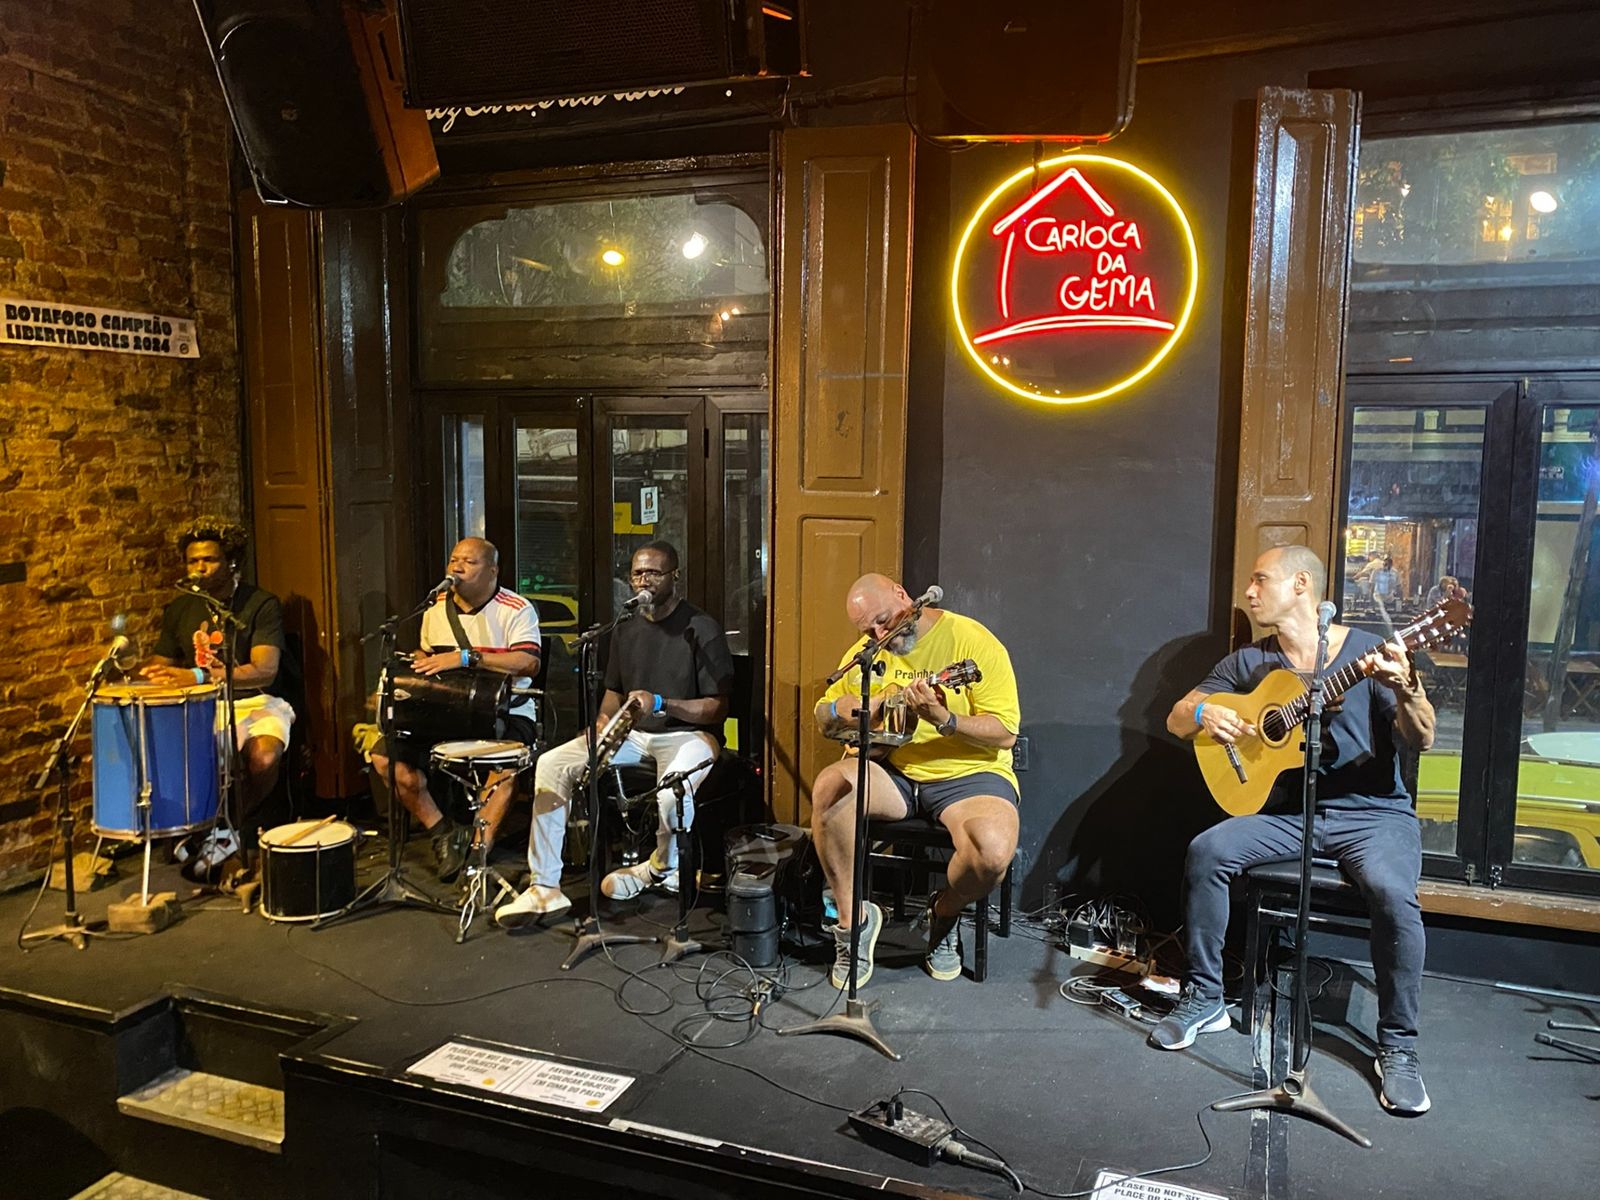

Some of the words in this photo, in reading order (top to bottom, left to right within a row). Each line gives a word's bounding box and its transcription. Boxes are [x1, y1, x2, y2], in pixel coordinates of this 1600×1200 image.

[1025, 217, 1141, 252] CARIOCA
[1096, 251, 1127, 275] DA
[1060, 276, 1155, 311] GEMA
[101, 314, 173, 337] CAMPEÃO
[6, 323, 129, 348] LIBERTADORES
[133, 337, 170, 353] 2024
[449, 1047, 475, 1055] PLEASE
[446, 1054, 467, 1062] PLACE
[467, 1058, 498, 1069] OBJECTS
[548, 1075, 583, 1086] COLOCAR
[582, 1080, 617, 1091] OBJETOS
[549, 1067, 573, 1075] FAVOR
[574, 1070, 590, 1078] NÃO
[590, 1074, 620, 1084] SENTAR
[546, 1082, 568, 1090] CIMA
[578, 1089, 605, 1098] PALCO
[1163, 1189, 1184, 1198] NOT
